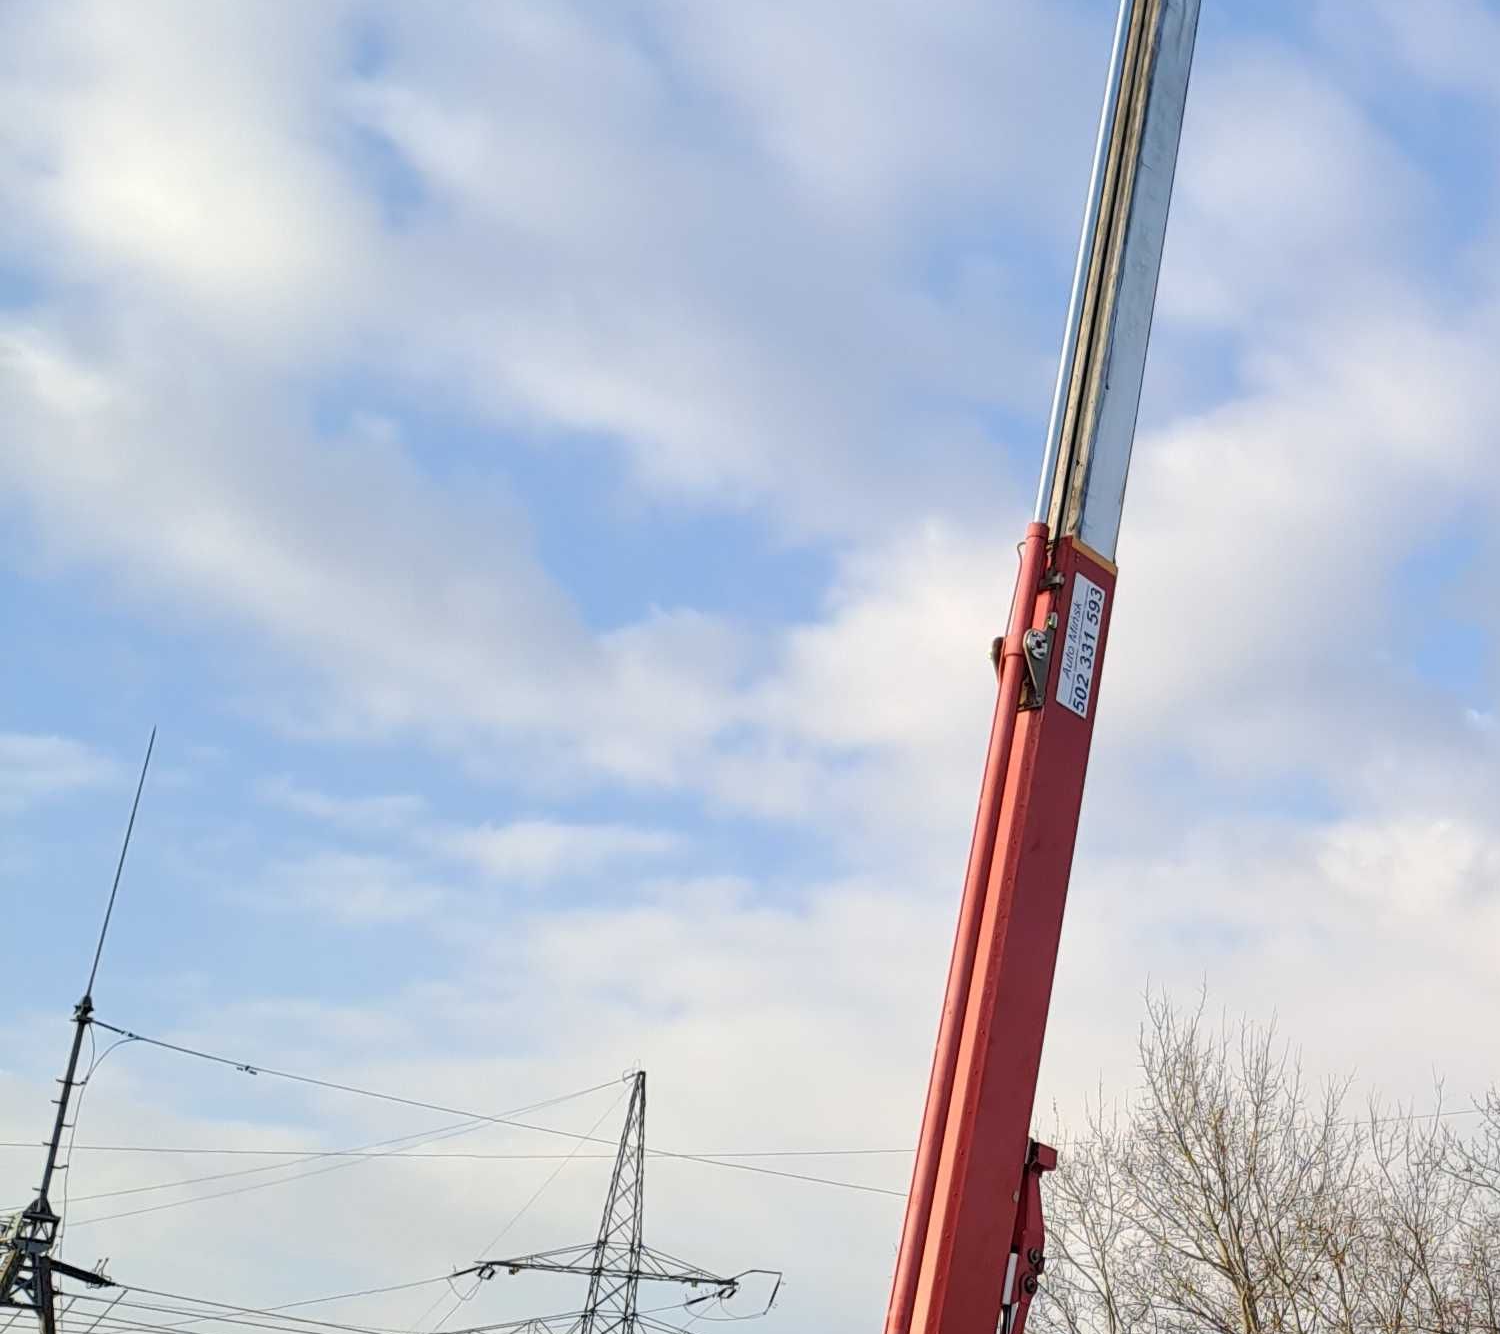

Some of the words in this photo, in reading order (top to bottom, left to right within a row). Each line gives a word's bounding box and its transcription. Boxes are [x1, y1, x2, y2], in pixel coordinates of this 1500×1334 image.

[1087, 587, 1103, 626] 593
[1063, 645, 1075, 680] Auto
[1080, 632, 1095, 669] 331
[1073, 673, 1089, 713] 502
